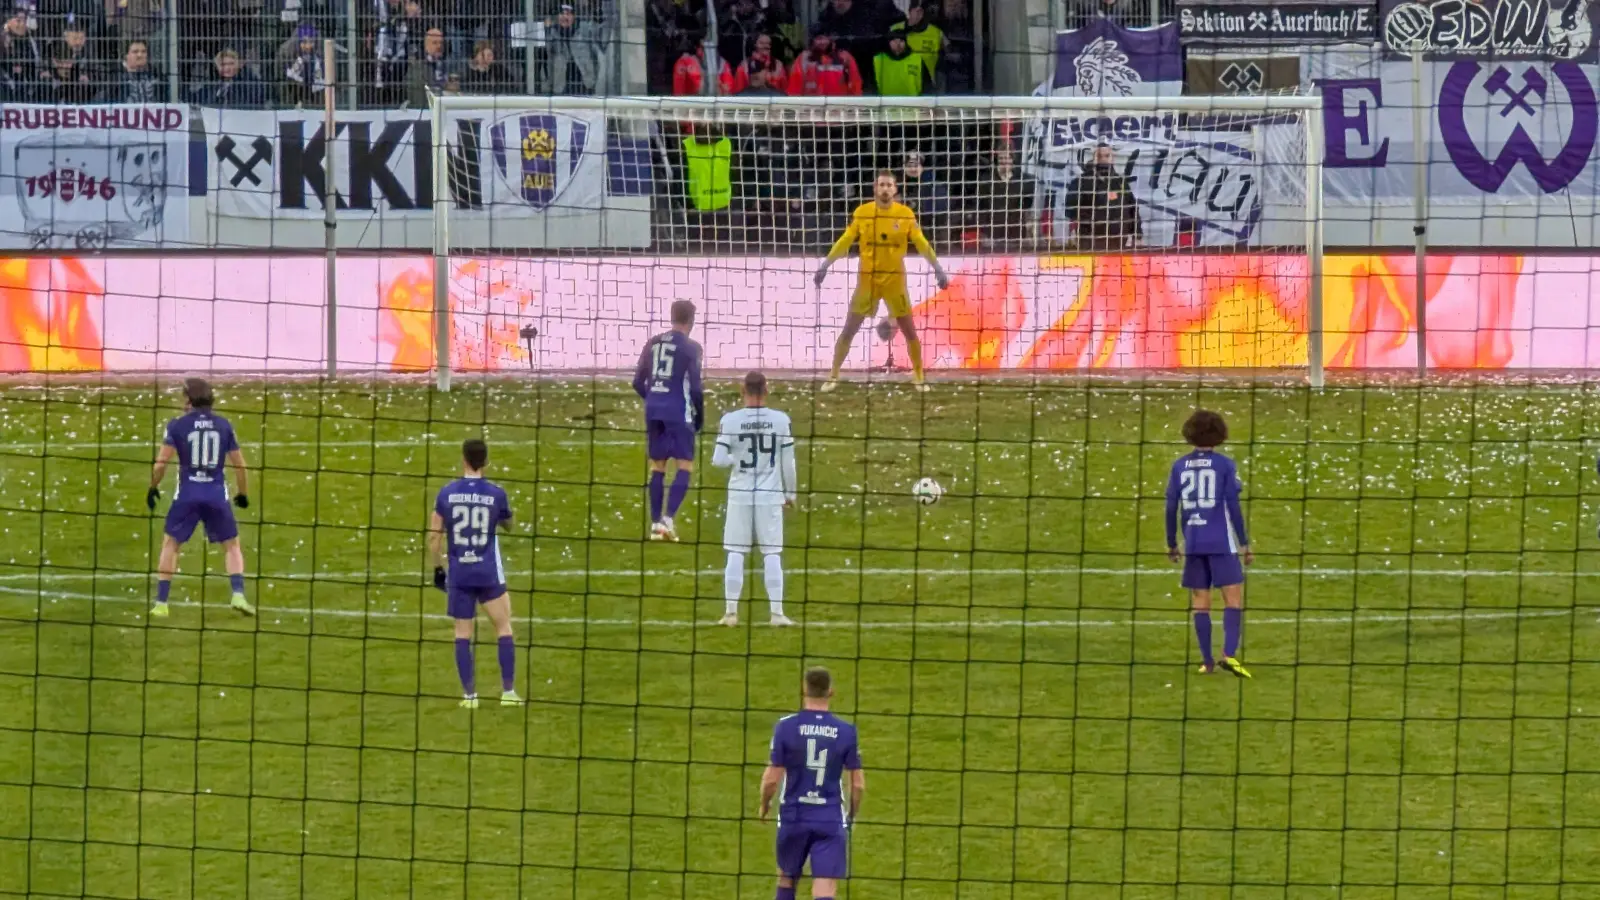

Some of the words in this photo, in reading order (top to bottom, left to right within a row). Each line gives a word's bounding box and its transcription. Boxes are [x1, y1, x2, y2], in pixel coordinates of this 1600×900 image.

[1181, 8, 1245, 32] Sektion
[1428, 0, 1549, 48] EDW
[0, 108, 183, 131] RUBENHUND
[1312, 78, 1389, 167] E
[652, 342, 677, 378] 15
[187, 430, 220, 468] 10
[738, 432, 777, 468] 34
[1180, 469, 1216, 510] 20
[452, 505, 490, 546] 29
[806, 738, 828, 786] 4
